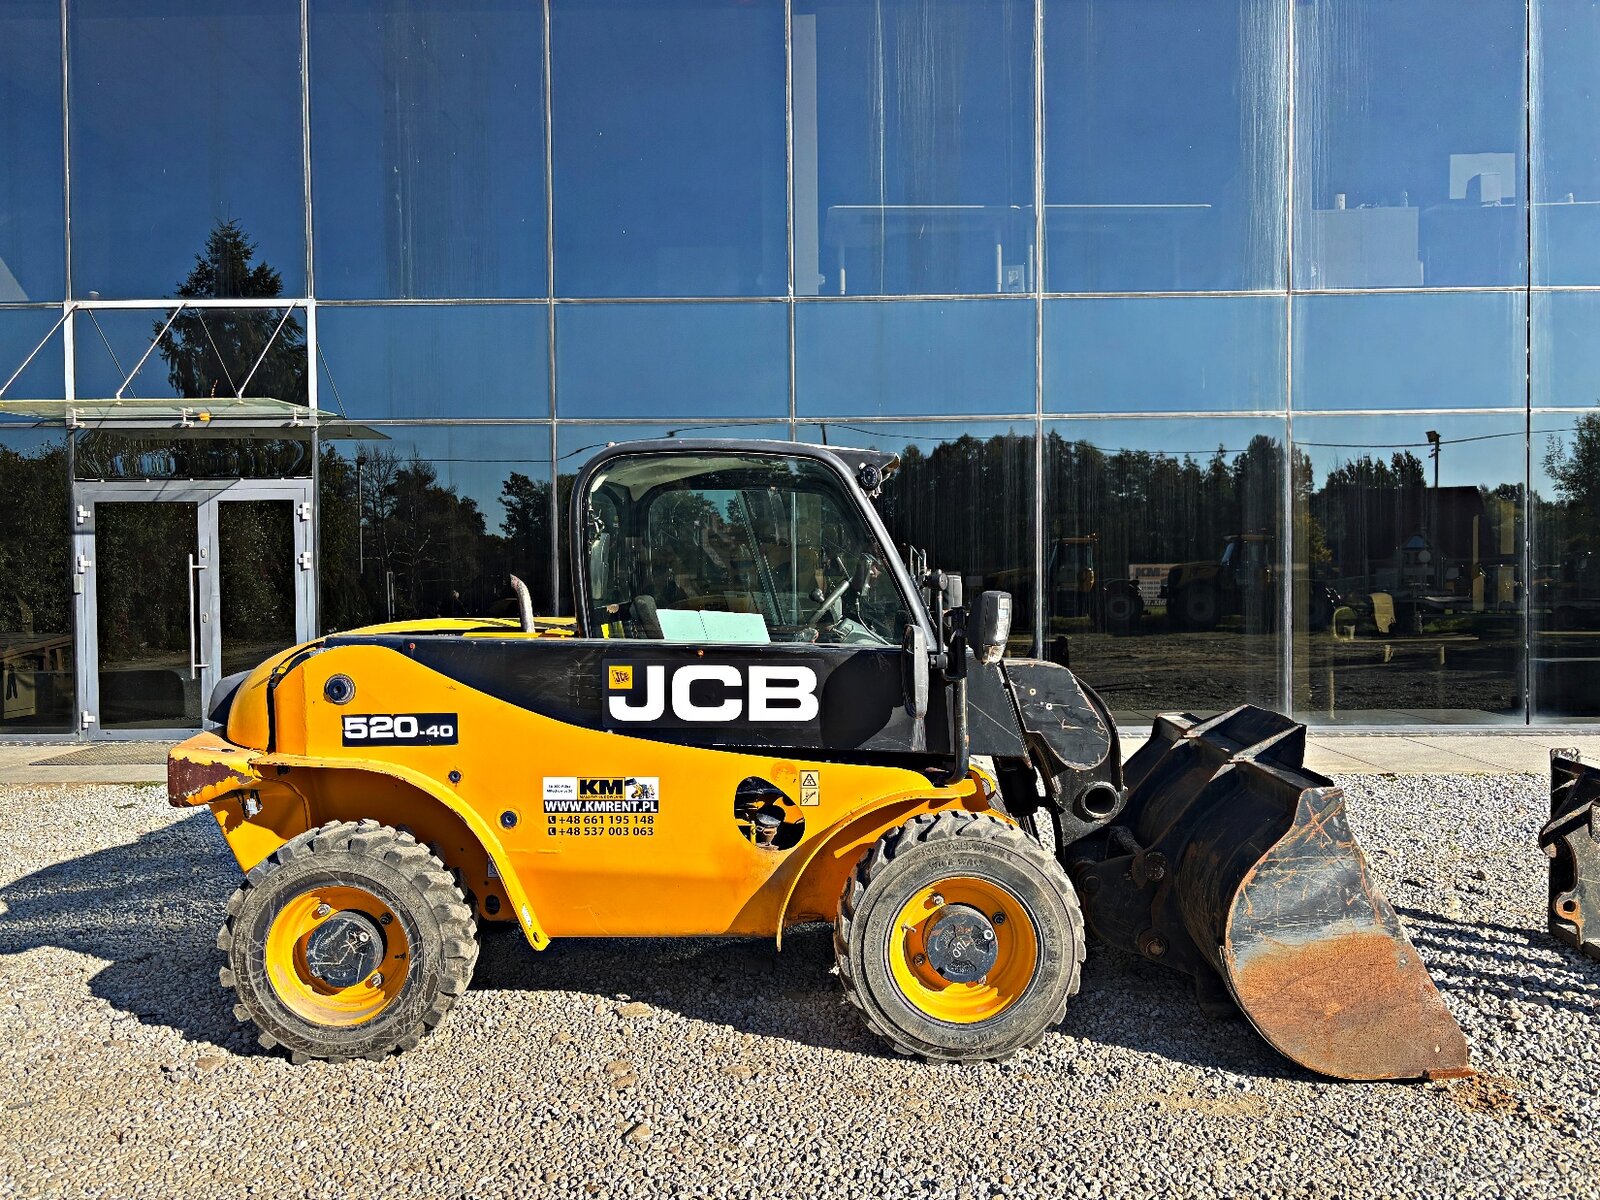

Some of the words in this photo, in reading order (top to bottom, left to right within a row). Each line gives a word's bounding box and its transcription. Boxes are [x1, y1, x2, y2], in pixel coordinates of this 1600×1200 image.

[609, 665, 819, 721] JCB
[344, 716, 454, 739] 520-40
[580, 779, 623, 794] KM
[544, 801, 657, 812] WWW.KMRENT.PL
[559, 816, 580, 824] +48
[584, 816, 604, 824] 661
[609, 816, 629, 824] 195
[634, 816, 654, 824] 148
[559, 827, 580, 835] +48
[584, 827, 604, 835] 537
[609, 827, 629, 835] 003
[633, 827, 654, 835] 063
